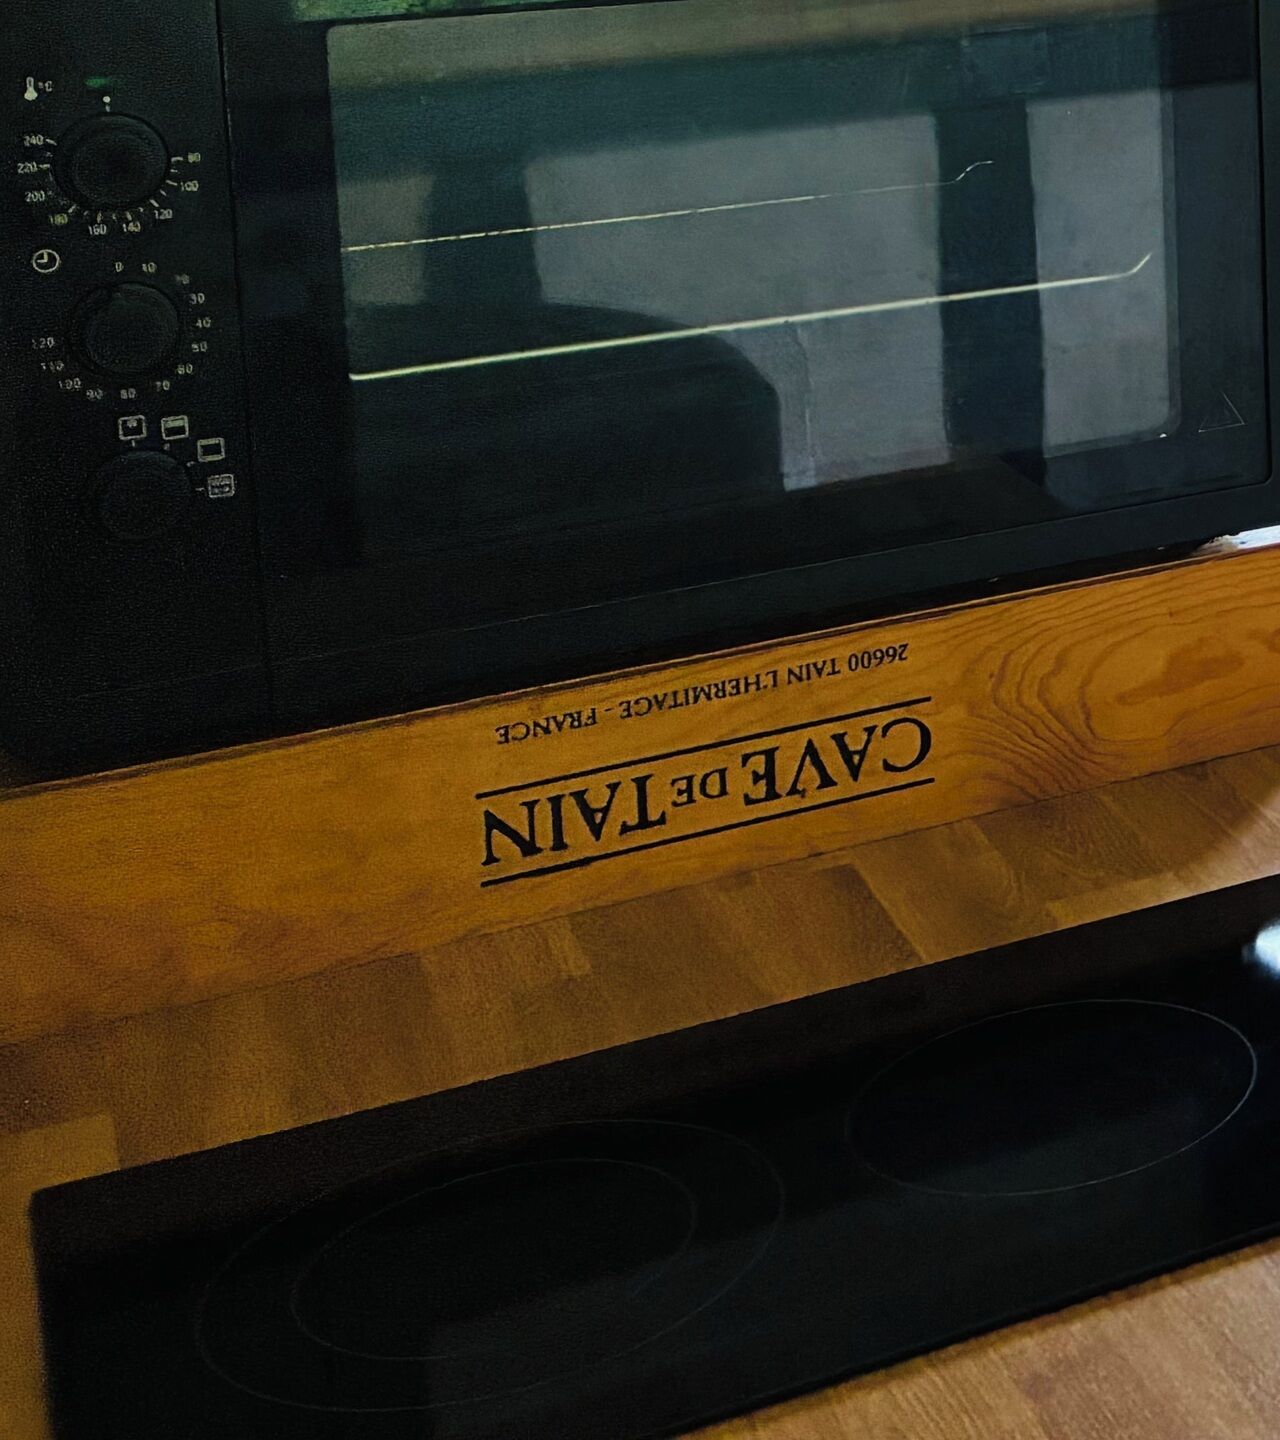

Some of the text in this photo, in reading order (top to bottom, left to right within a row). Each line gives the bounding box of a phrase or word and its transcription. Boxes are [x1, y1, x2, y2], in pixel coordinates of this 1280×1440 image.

[154, 208, 173, 220] 120
[784, 657, 843, 690] TAIN
[848, 643, 909, 671] 26600
[618, 668, 780, 721] L'HERMITAGE
[494, 706, 597, 745] FRANCE
[480, 716, 933, 867] CAVE DE TAIN
